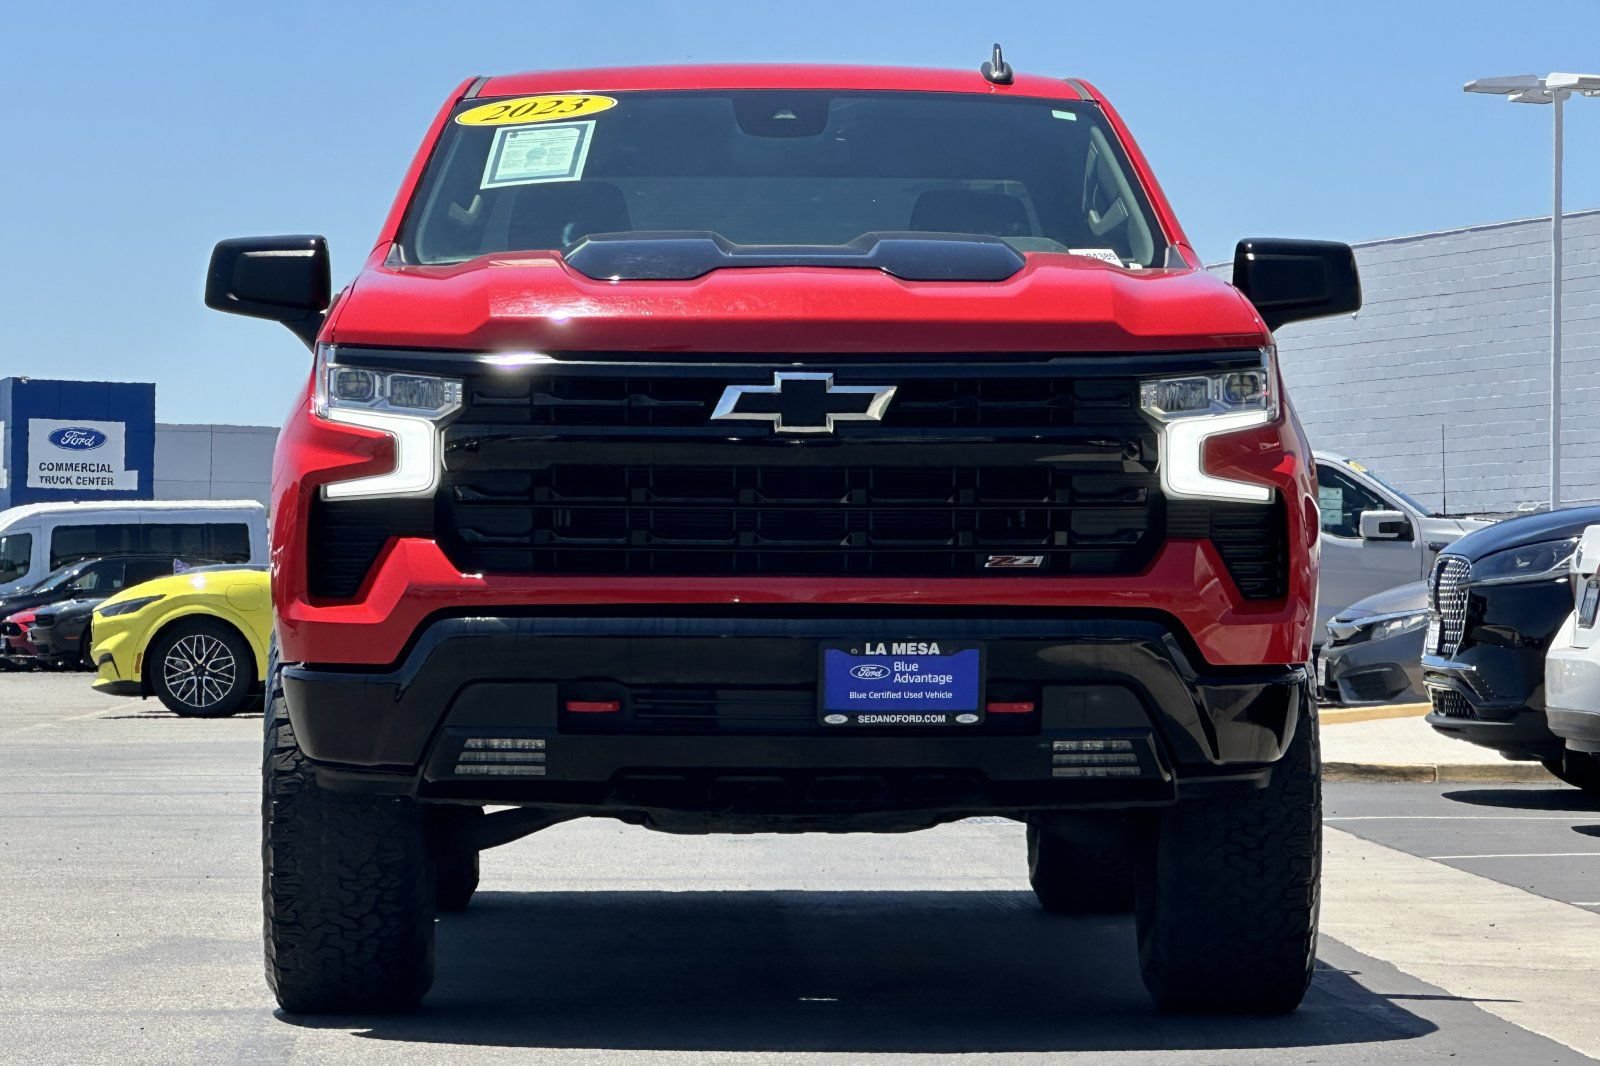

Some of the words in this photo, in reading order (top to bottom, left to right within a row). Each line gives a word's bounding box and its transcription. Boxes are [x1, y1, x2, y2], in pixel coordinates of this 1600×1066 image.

[480, 97, 590, 122] 2023
[60, 430, 95, 447] Ford
[38, 462, 114, 474] COMMERCIAL
[39, 475, 73, 485] TRUCK
[75, 476, 114, 486] CENTER
[865, 642, 887, 655] LA
[892, 642, 940, 655] MESA
[857, 666, 883, 678] Ford
[893, 661, 919, 672] Blue
[893, 673, 953, 685] Advantage
[849, 691, 867, 699] Blue
[868, 691, 901, 699] Certified
[903, 691, 923, 699] Used
[925, 691, 953, 699] Vehicle
[858, 714, 946, 723] SEDANOFORD.COM
